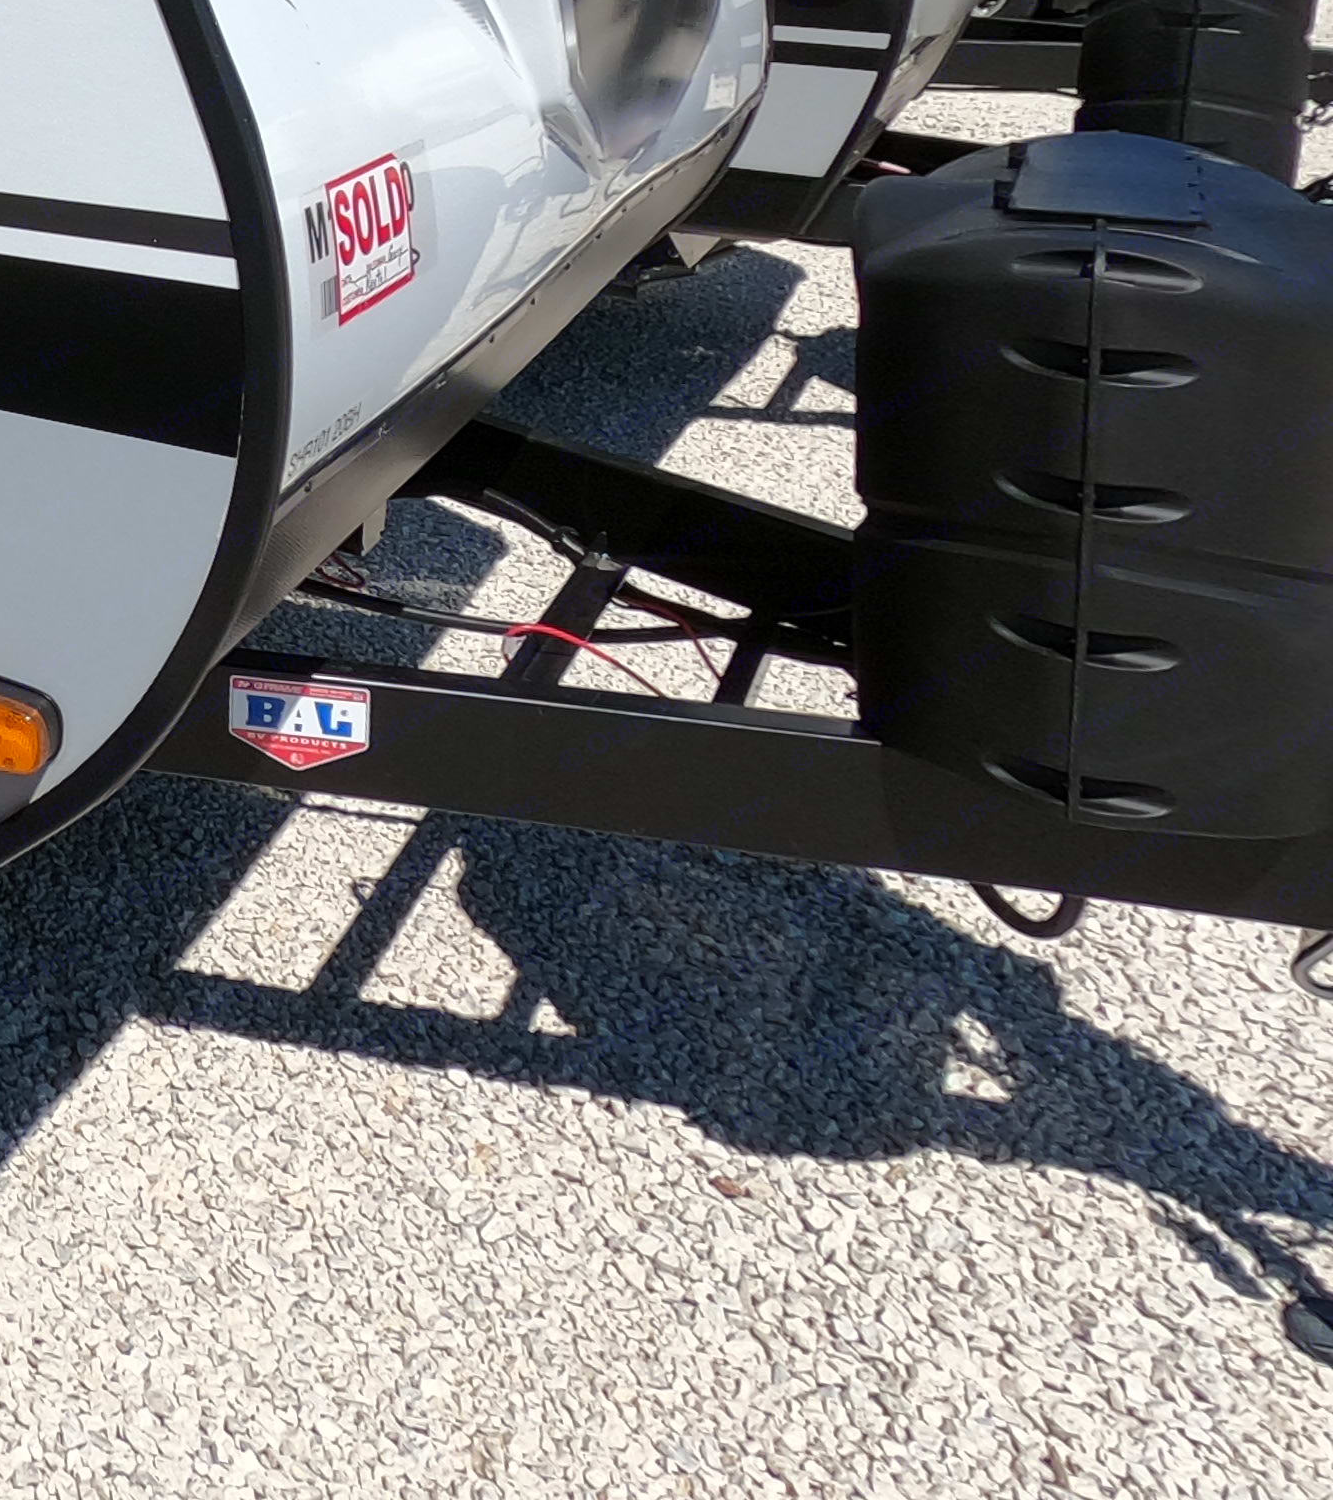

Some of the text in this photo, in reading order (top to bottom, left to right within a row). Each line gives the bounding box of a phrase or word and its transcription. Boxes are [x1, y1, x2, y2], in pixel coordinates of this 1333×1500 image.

[334, 165, 406, 267] SOLD
[245, 694, 353, 738] BAL
[270, 735, 348, 750] PRODUCTS
